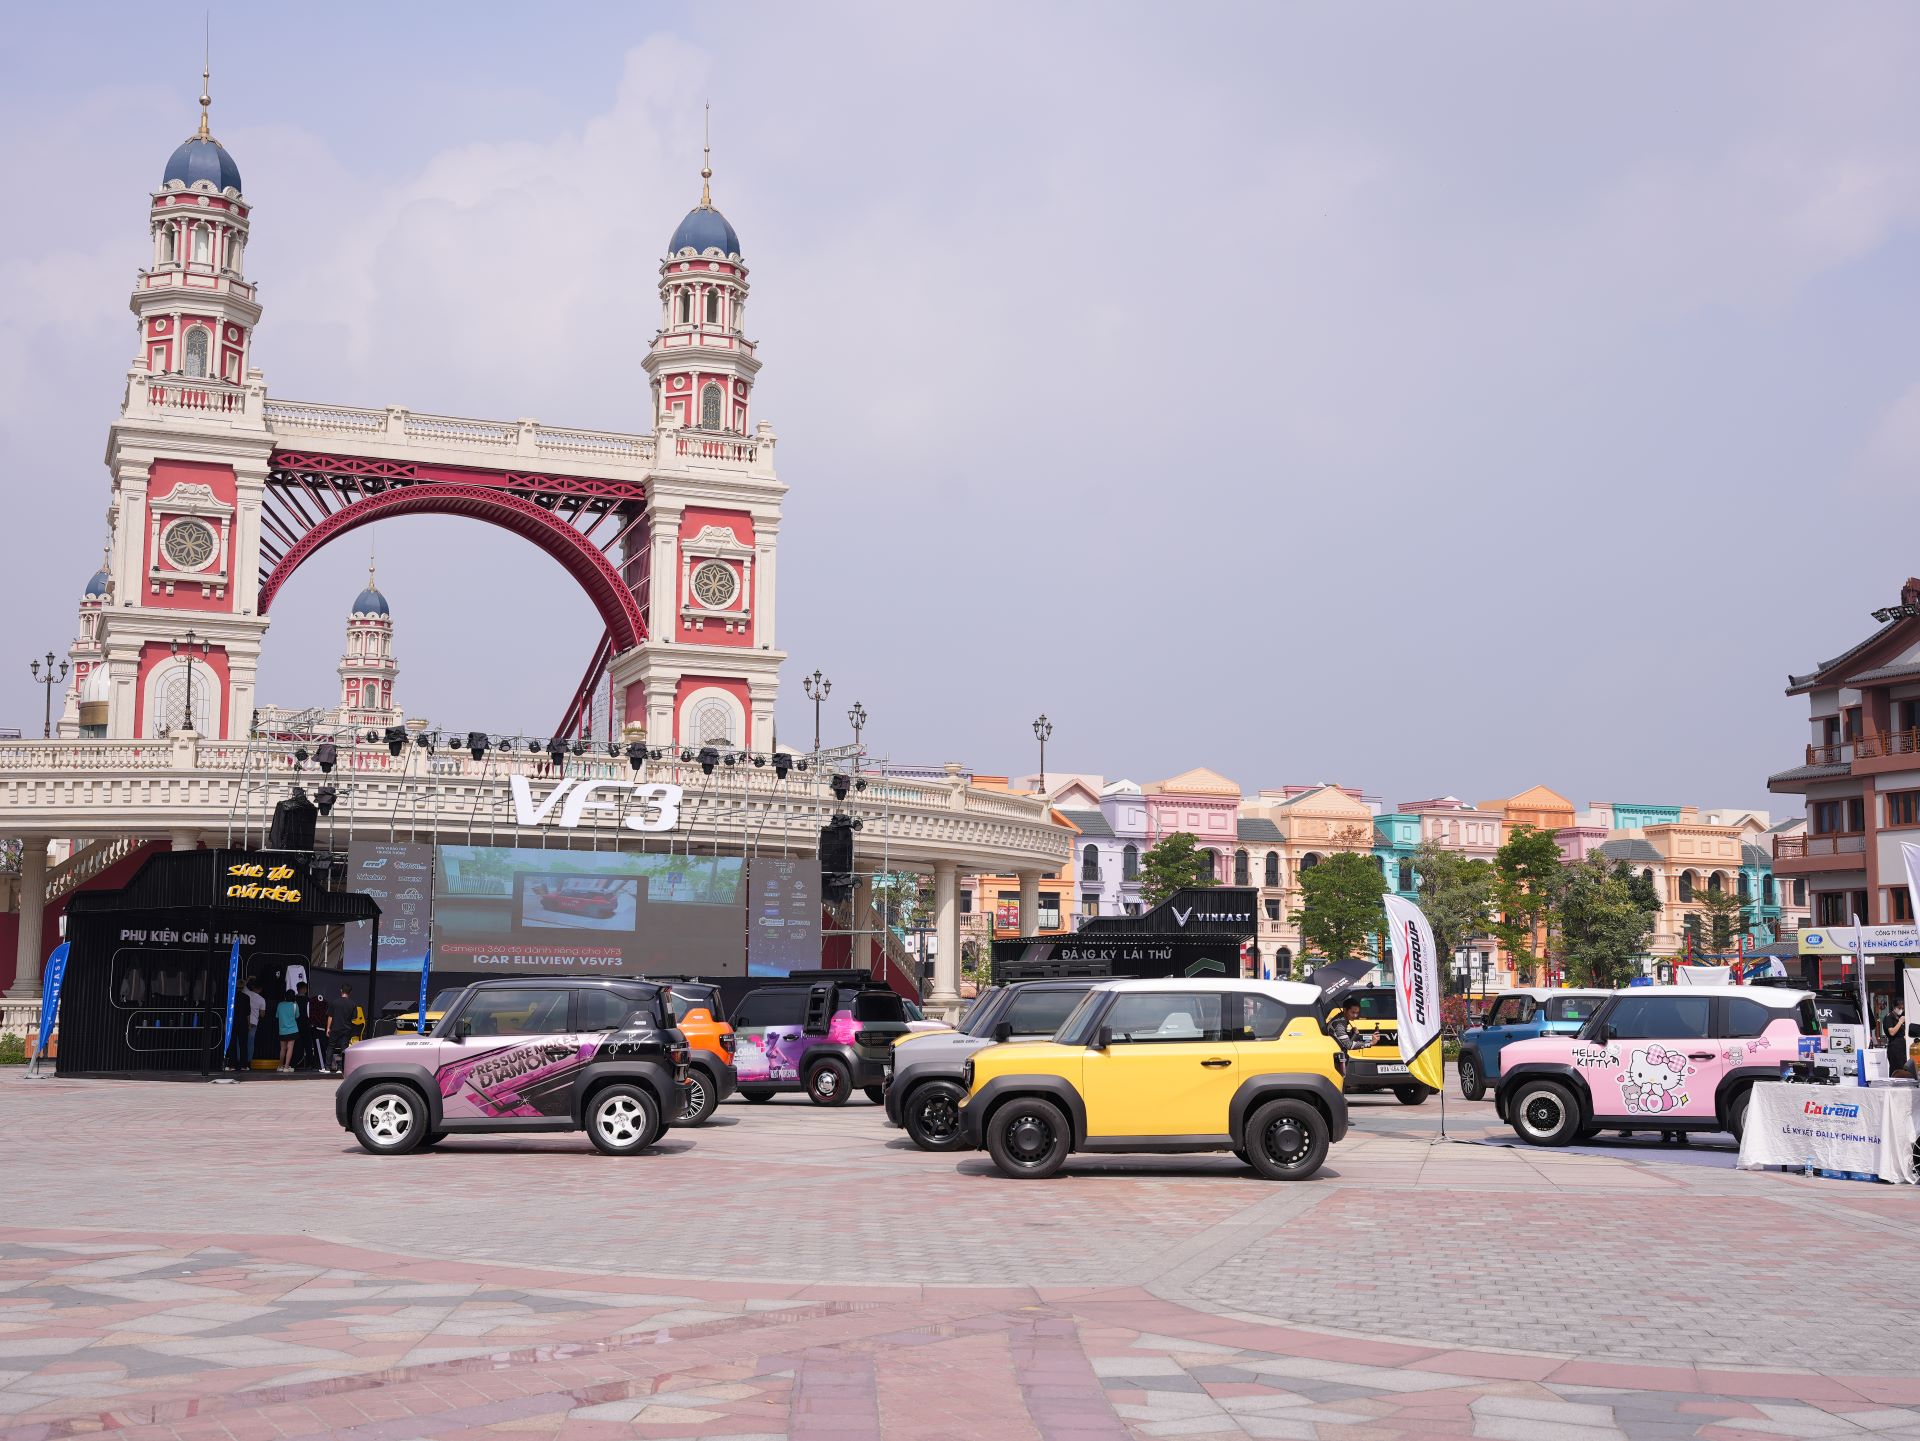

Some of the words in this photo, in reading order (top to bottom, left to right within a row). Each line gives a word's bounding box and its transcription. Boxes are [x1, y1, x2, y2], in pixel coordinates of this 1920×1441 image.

[1196, 913, 1251, 922] VINFAST
[120, 929, 147, 945] PHỤ
[150, 927, 179, 946] KIỆN
[1849, 938, 1877, 948] CHYÊN
[1898, 937, 1914, 947] CẤP
[441, 944, 485, 953] Camera
[487, 945, 506, 953] 360
[581, 947, 601, 955] cho
[1408, 919, 1423, 974] GROUP
[1100, 946, 1117, 960] KÝ
[1123, 946, 1143, 959] LÁI
[1147, 946, 1173, 959] THỬ
[473, 955, 509, 964] ICAR
[514, 955, 575, 965] ELLIVIEW
[579, 957, 623, 966] V5VF3
[1414, 973, 1426, 1025] CHUNG
[1571, 1048, 1607, 1058] HELLO
[469, 1045, 534, 1079] PRESSURE
[1576, 1057, 1611, 1069] KITTY
[1816, 1130, 1829, 1140] ĐẠI
[1841, 1133, 1866, 1143] CHÍNH
